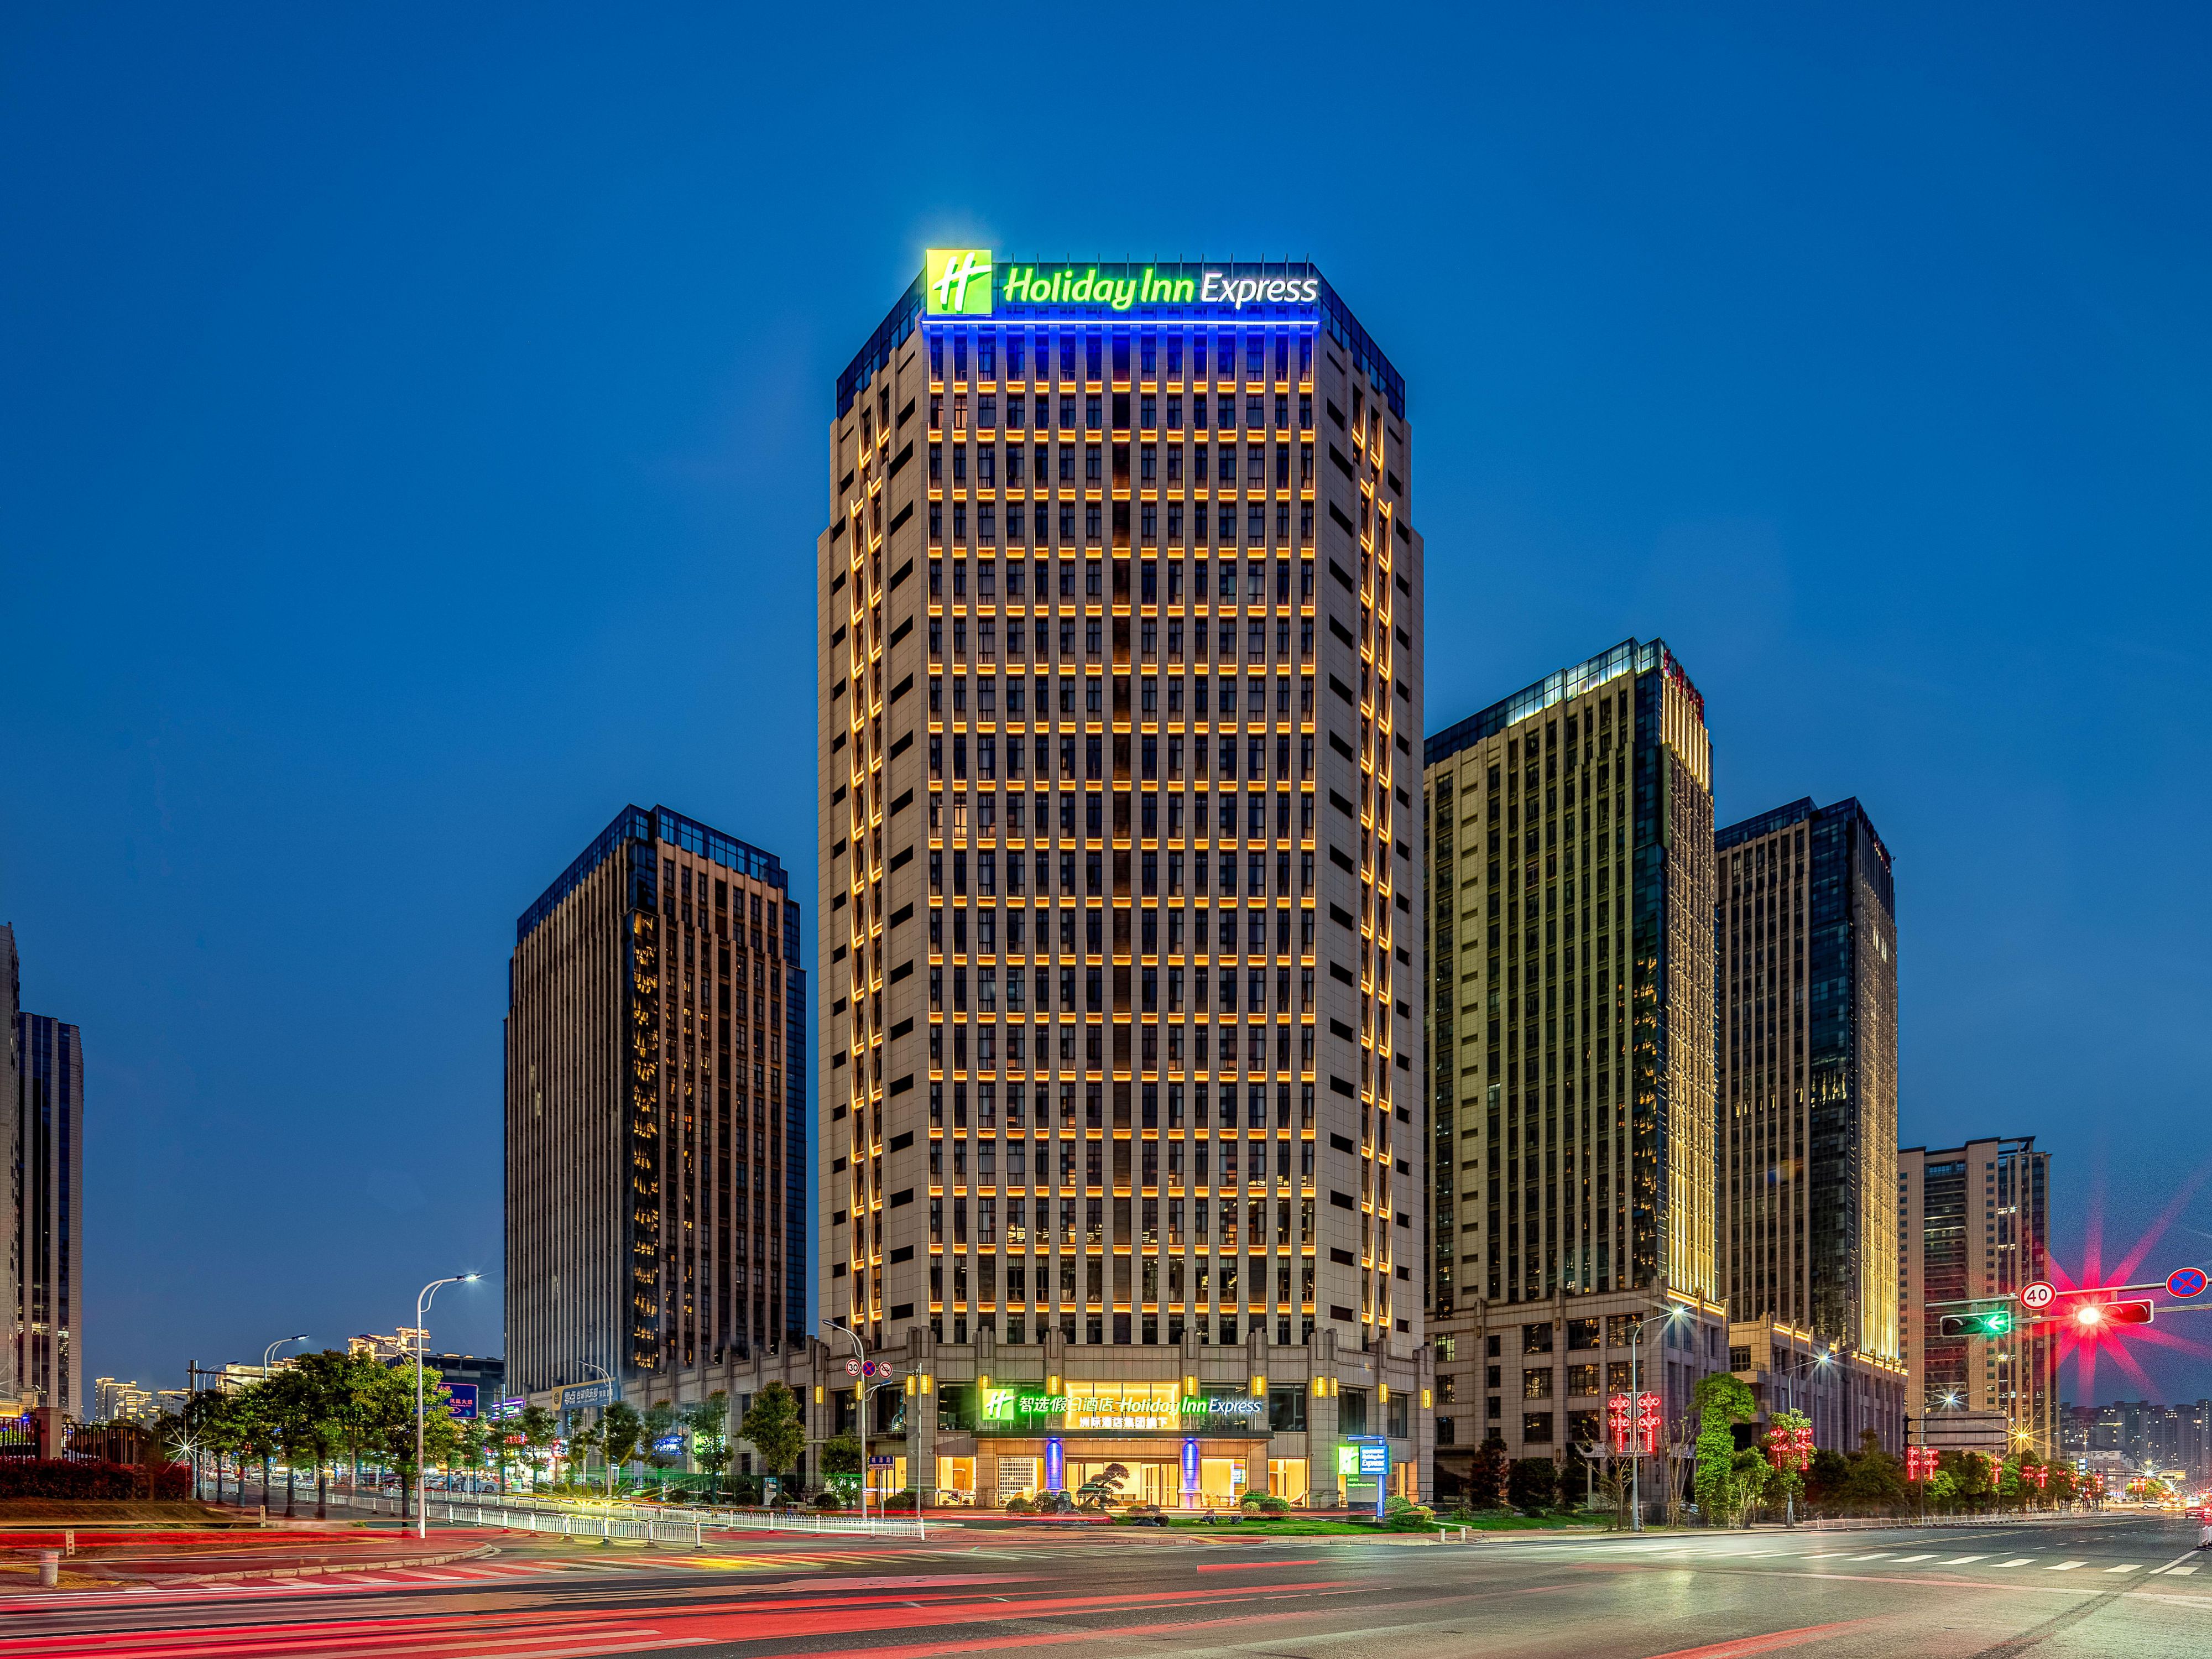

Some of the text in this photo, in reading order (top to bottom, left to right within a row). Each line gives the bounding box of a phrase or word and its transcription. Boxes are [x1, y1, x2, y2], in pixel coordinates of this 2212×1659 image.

[1004, 268, 1318, 310] Holiday Inn Express
[2027, 1289, 2047, 1302] 40
[1019, 1396, 1261, 1416] 智选假日酒店 Holiday Inn Express
